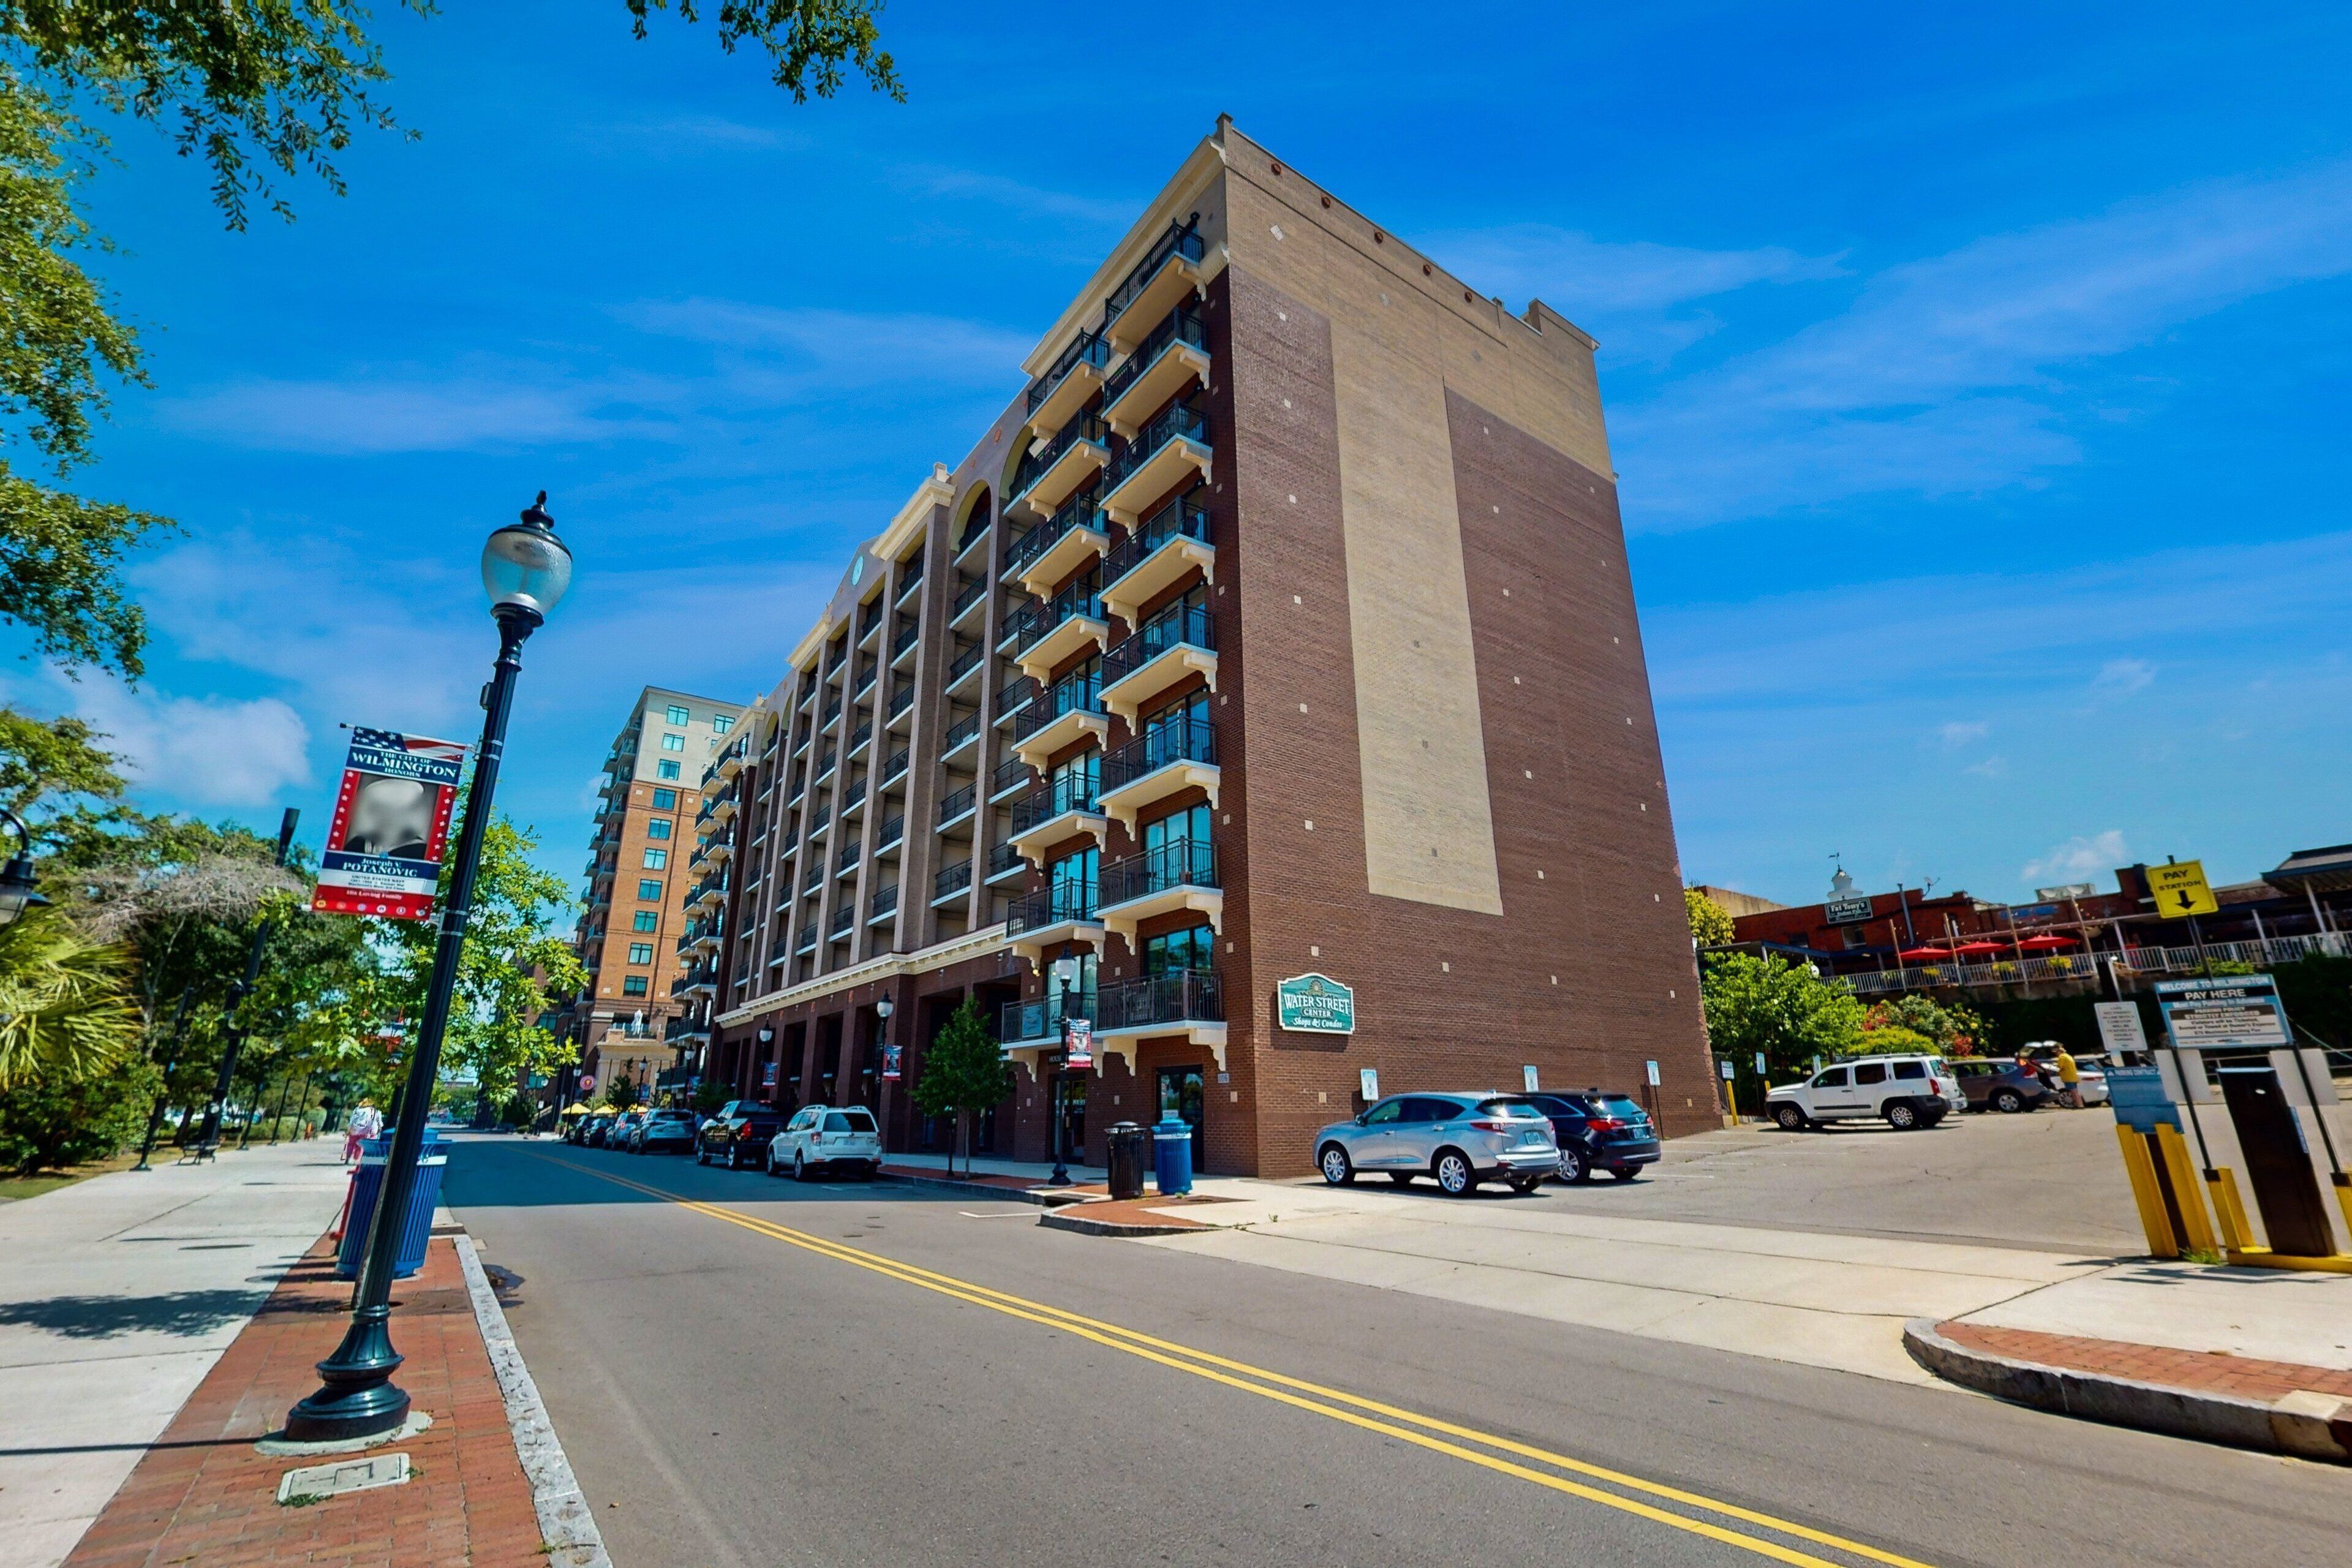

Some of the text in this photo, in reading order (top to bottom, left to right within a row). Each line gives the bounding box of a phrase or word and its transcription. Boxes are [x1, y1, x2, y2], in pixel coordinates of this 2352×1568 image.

[352, 752, 457, 778] WILMINGTON
[385, 767, 420, 777] HONORS
[361, 858, 393, 867] Joseph
[342, 862, 418, 877] POTANOVIC
[2163, 870, 2188, 880] PAY
[2158, 880, 2202, 891] STATION
[2159, 981, 2199, 991] WELCOME
[2212, 976, 2269, 987] WILMINGTON
[2184, 989, 2247, 1000] PAY HERE
[1283, 993, 1349, 1015] WATER STREET
[1293, 1017, 1343, 1028] Shops & Condos
